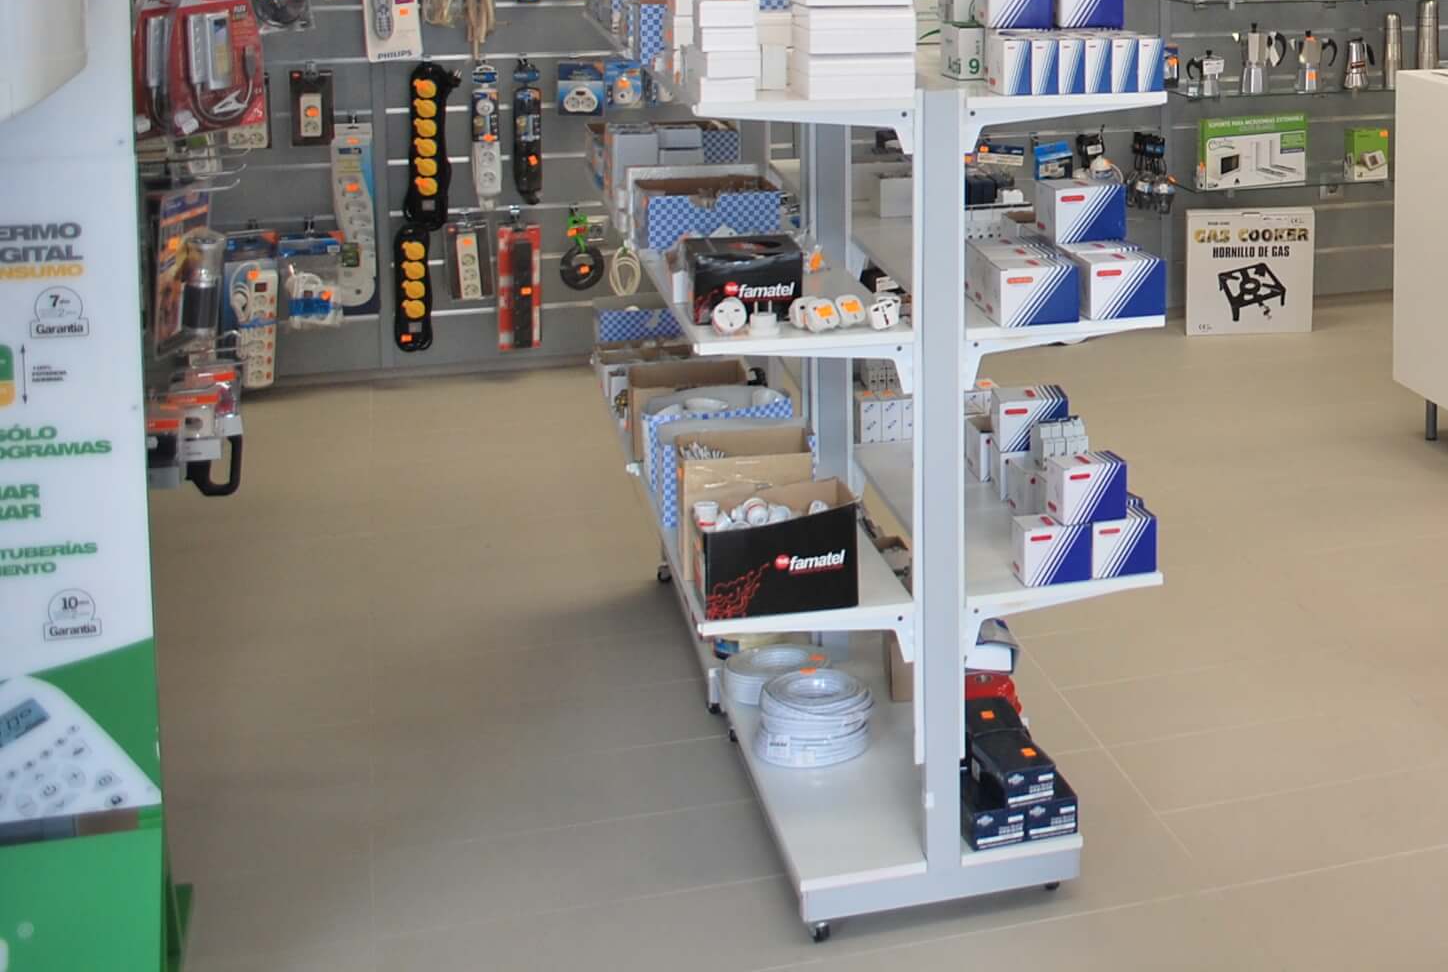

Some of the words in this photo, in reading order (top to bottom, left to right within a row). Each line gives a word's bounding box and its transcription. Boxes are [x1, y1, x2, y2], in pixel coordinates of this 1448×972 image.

[378, 50, 413, 60] PHILIPS
[969, 58, 980, 75] 9
[1193, 228, 1231, 244] GAS
[1238, 227, 1309, 243] COOKER
[1212, 246, 1255, 259] HORNILLO
[1258, 245, 1269, 258] DE
[1271, 245, 1290, 258] GAS
[739, 281, 795, 299] famatel
[50, 294, 60, 308] 7
[789, 548, 846, 570] famatel
[62, 596, 78, 611] 10
